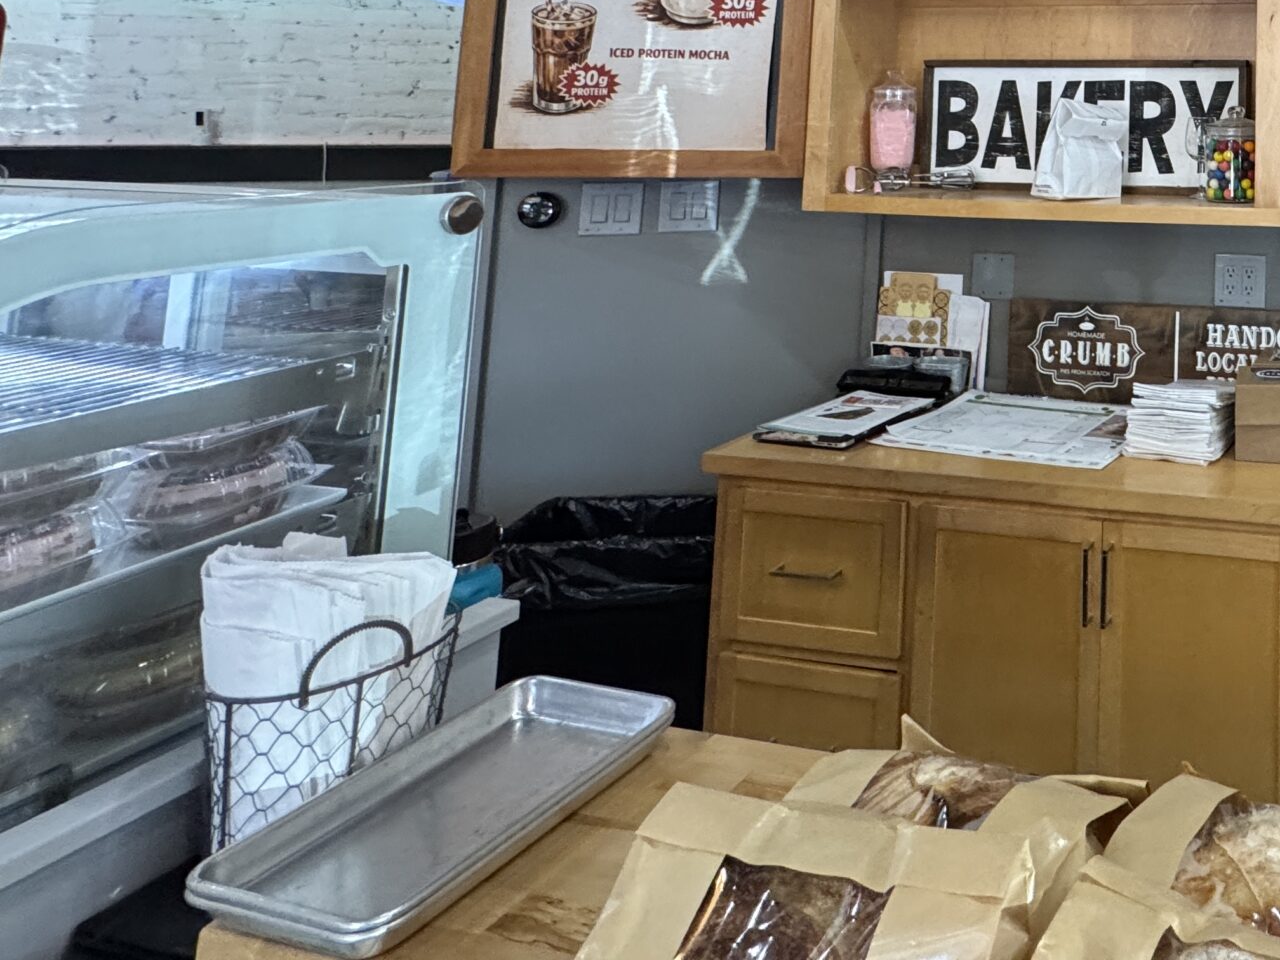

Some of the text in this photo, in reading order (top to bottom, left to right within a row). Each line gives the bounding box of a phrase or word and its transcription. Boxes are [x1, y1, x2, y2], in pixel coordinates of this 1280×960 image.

[719, 10, 756, 20] PROTEIN
[609, 47, 731, 61] ICED PROTEIN MOCHA
[573, 69, 609, 88] 30g
[571, 87, 609, 98] PROTEIN
[1067, 330, 1106, 340] HOMEMADE
